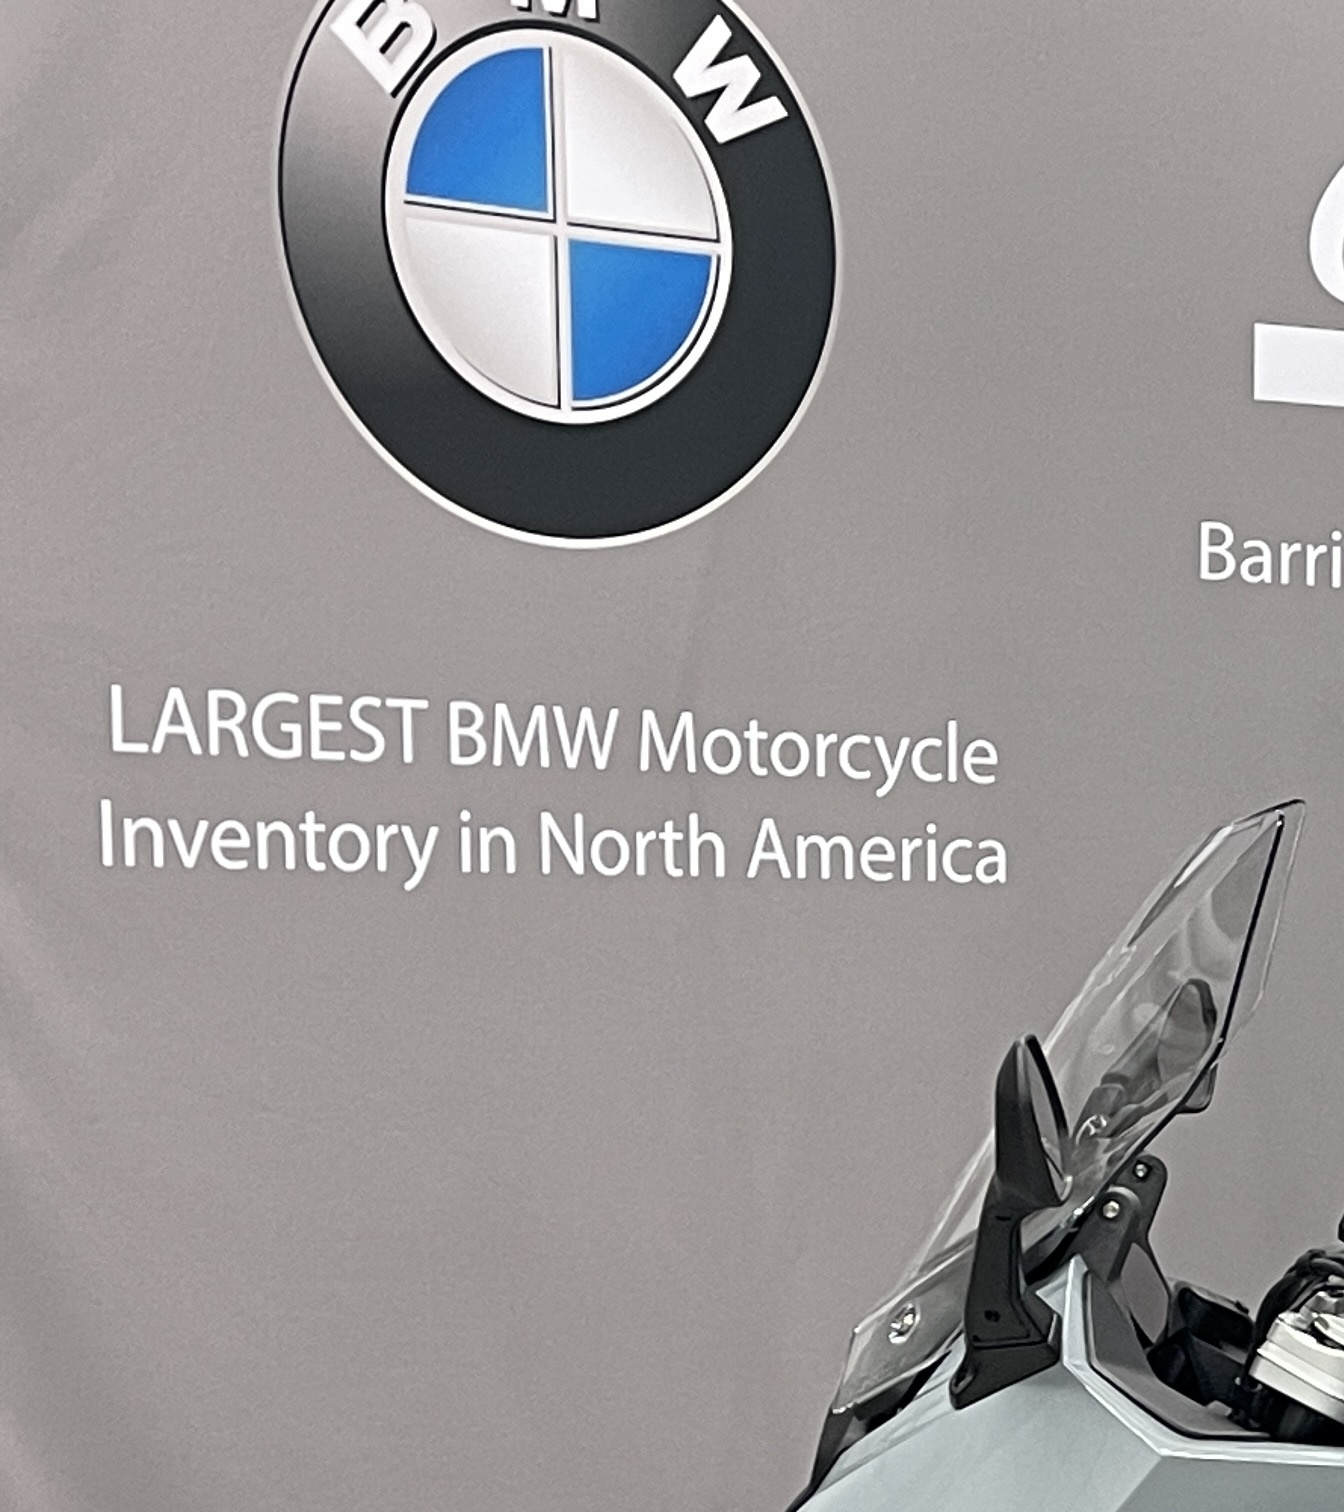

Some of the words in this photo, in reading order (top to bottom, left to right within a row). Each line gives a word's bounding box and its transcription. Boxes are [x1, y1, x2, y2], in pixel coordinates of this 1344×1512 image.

[330, 0, 788, 144] BW
[109, 683, 430, 765] LARGEST
[448, 699, 620, 771] BMW
[639, 708, 999, 799] Motorcycle
[99, 797, 440, 893] Inventory
[459, 808, 517, 875] in
[539, 810, 726, 879] North
[746, 817, 1008, 885] America
